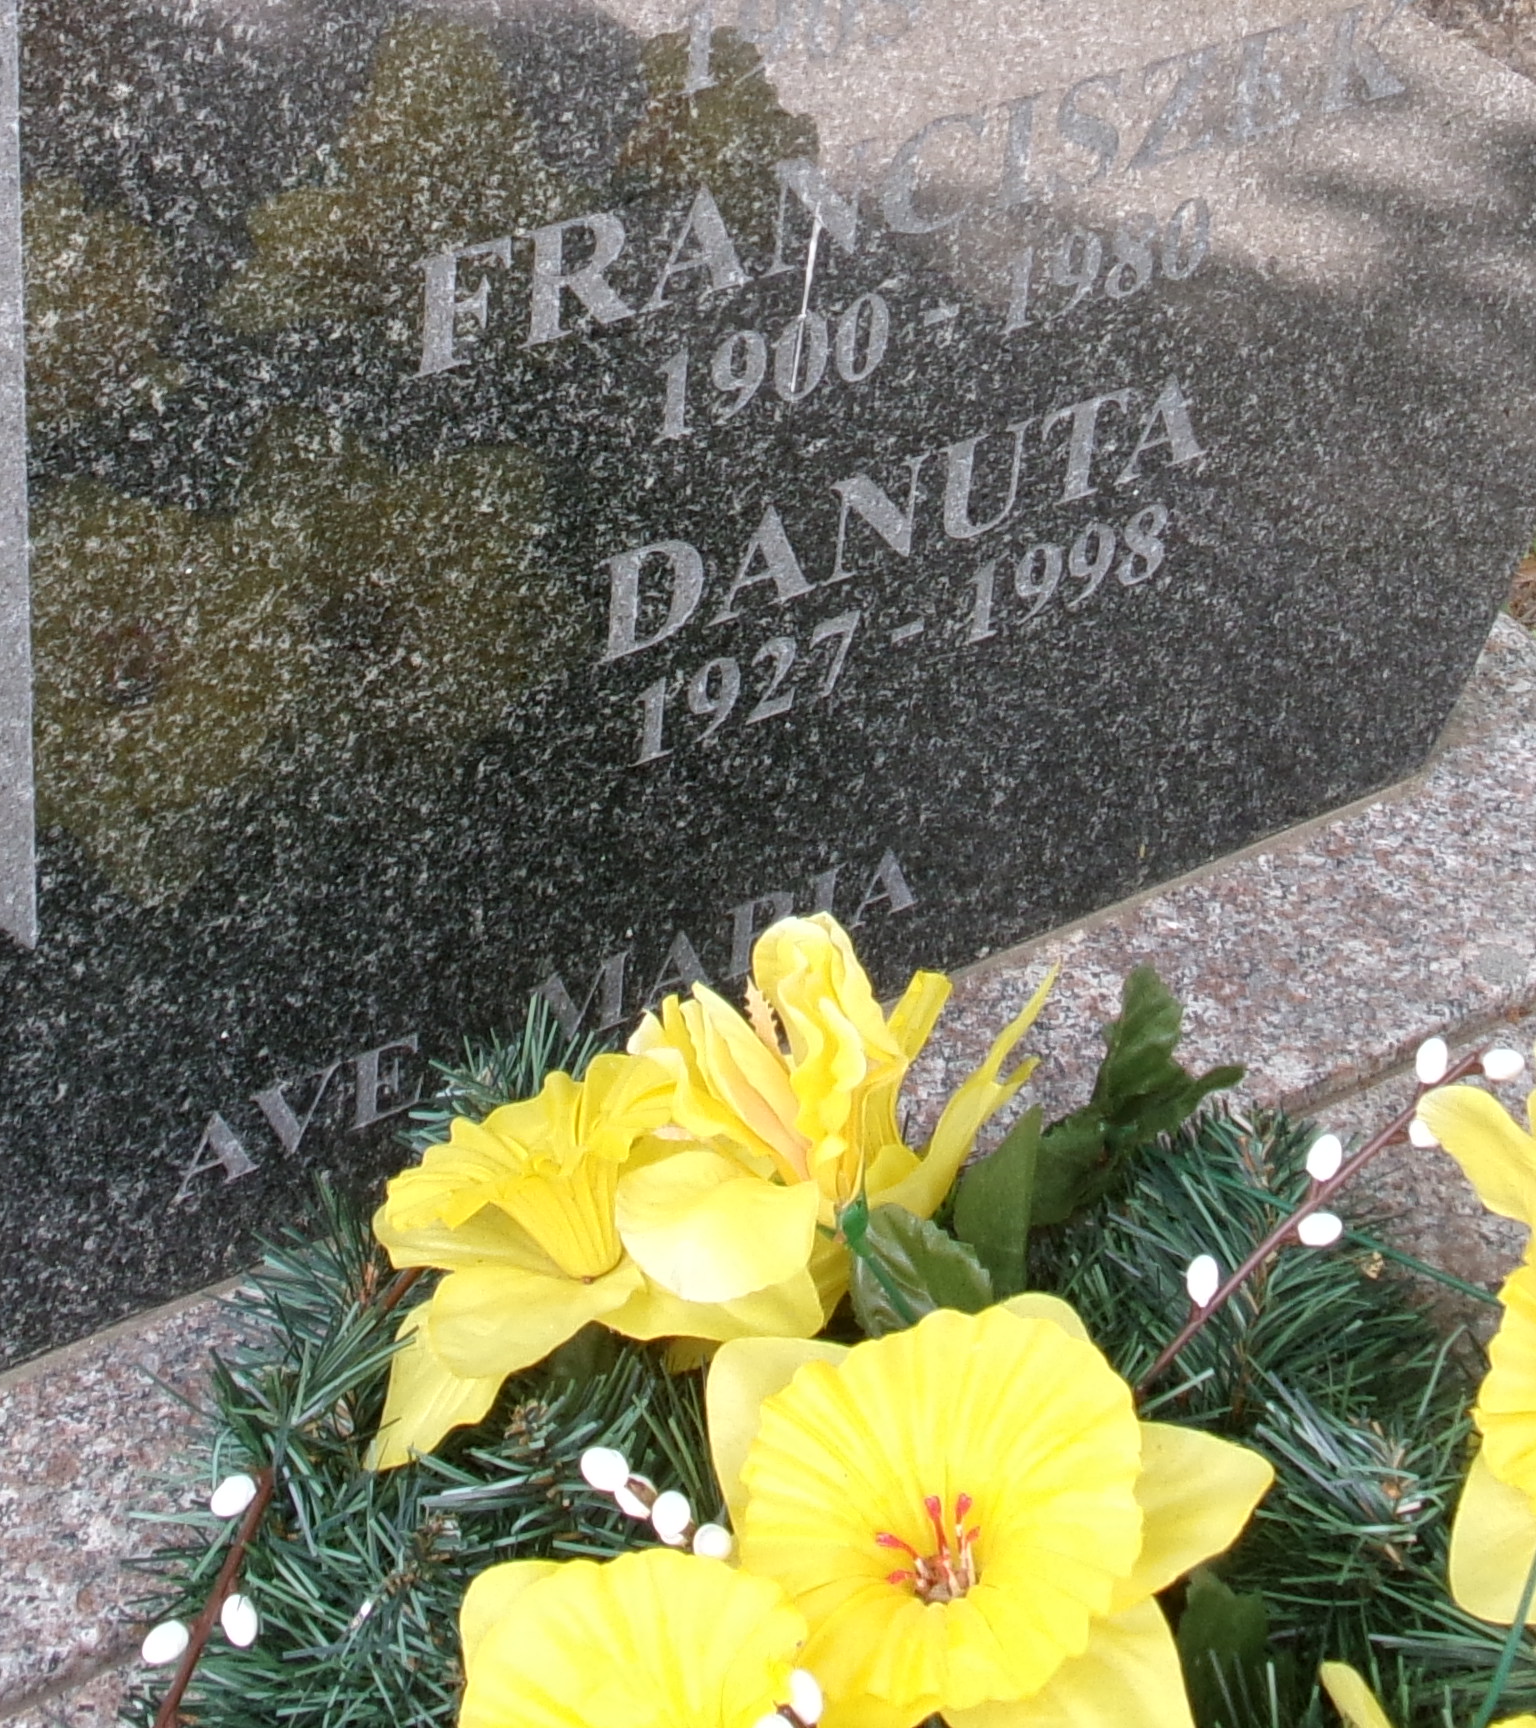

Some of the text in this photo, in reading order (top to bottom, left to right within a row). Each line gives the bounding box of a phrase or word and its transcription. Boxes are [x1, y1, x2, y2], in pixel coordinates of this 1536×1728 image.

[662, 291, 890, 443] 1900
[1005, 197, 1212, 335] 1980
[599, 376, 1209, 664] DANUTA
[631, 610, 860, 767] 1927
[965, 503, 1170, 647] 1998
[167, 1033, 424, 1206] AVE
